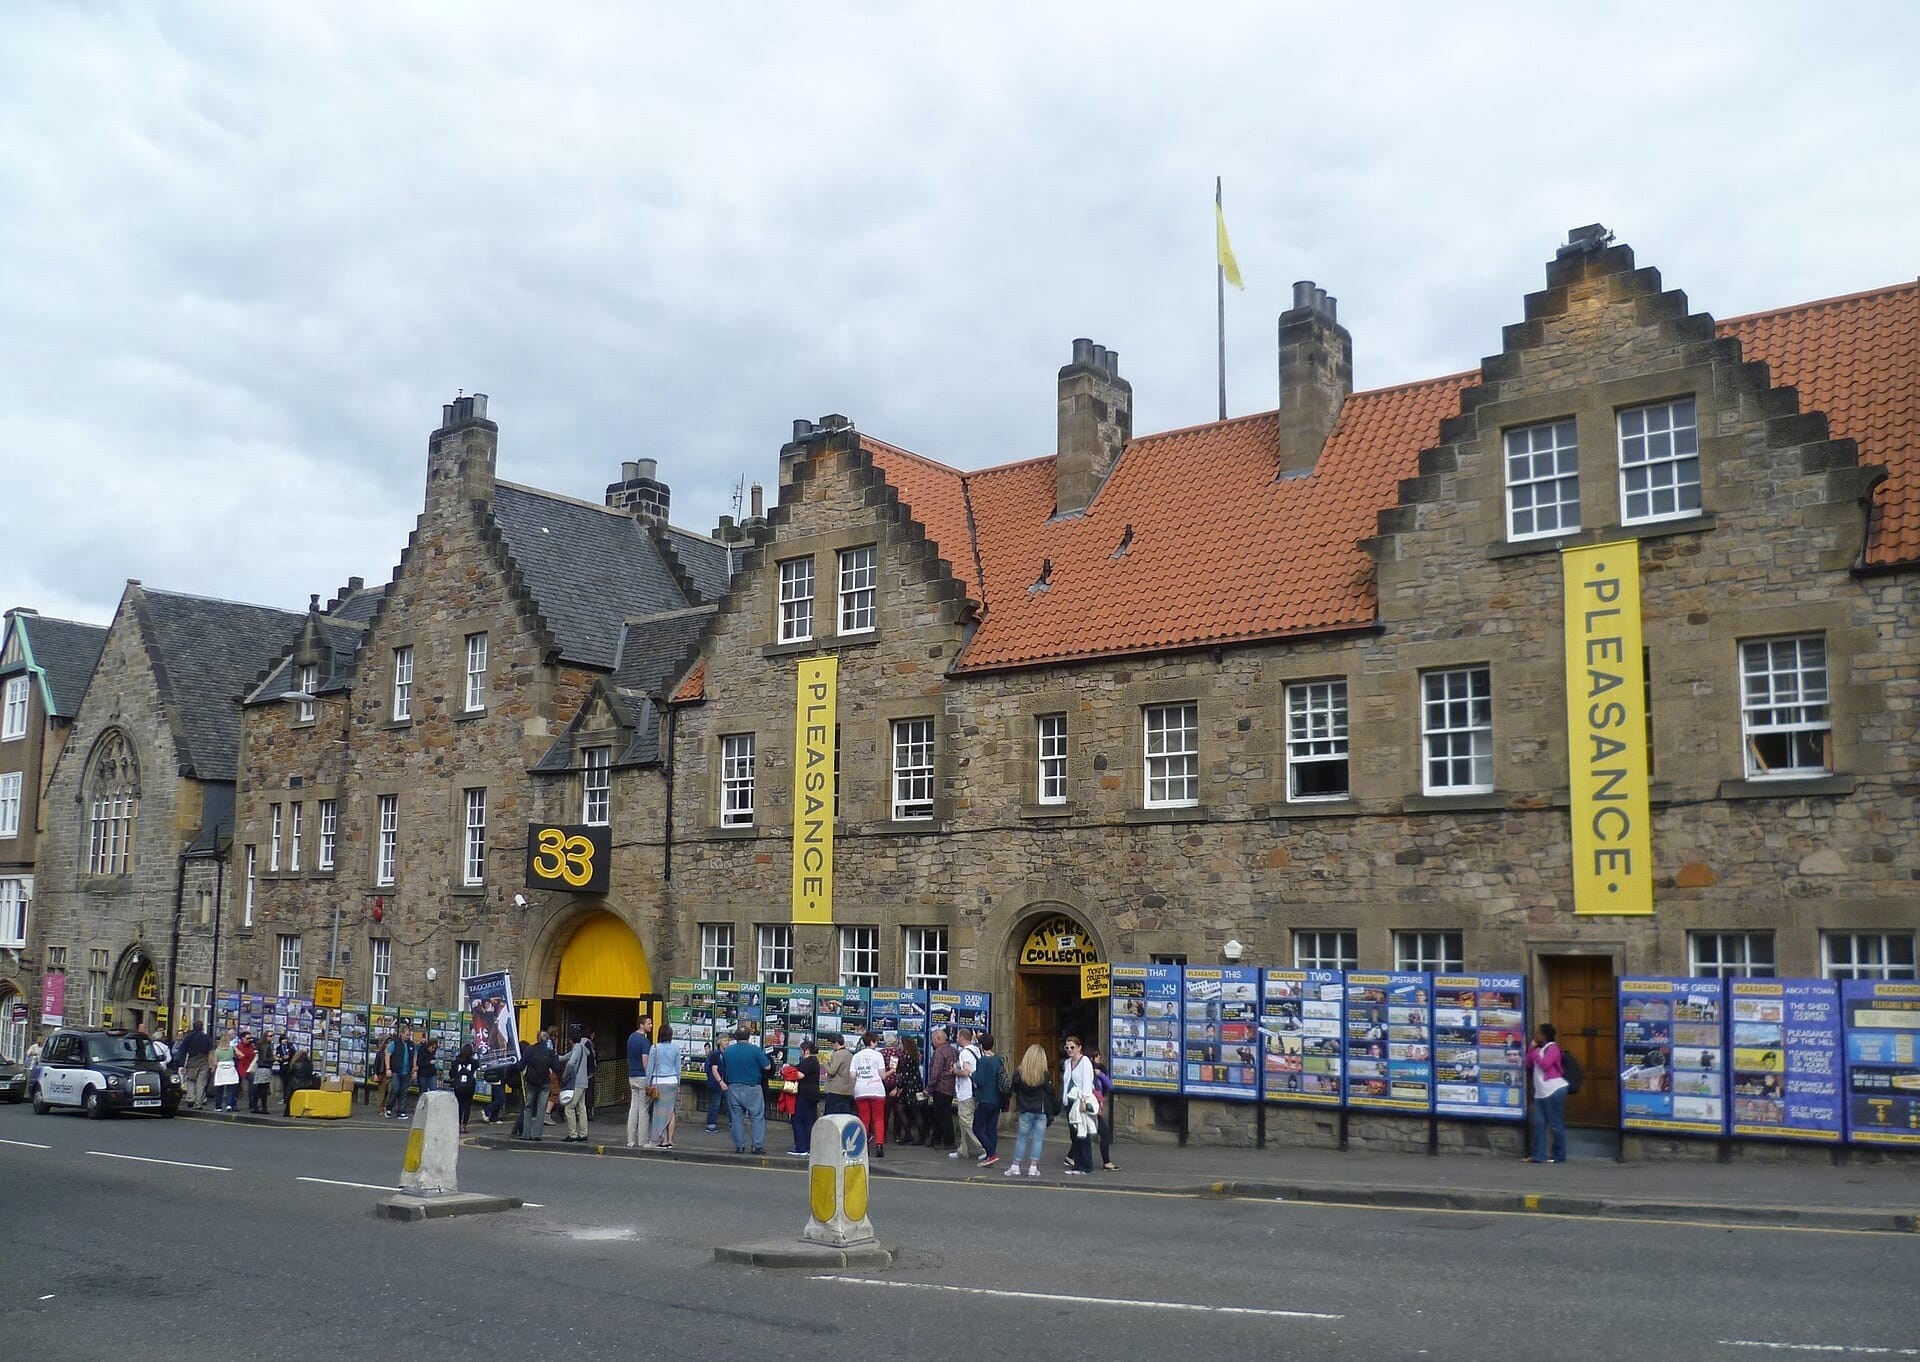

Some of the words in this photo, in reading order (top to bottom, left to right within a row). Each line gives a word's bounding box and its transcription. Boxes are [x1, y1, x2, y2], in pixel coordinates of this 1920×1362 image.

[1583, 578, 1632, 876] PLEASANCE
[803, 683, 827, 897] PLEASANCE
[534, 829, 595, 887] 33
[1149, 969, 1168, 977] THAT
[1224, 970, 1242, 978] THIS
[1310, 972, 1332, 982] TWO
[1387, 975, 1423, 984] UPSTAIRS
[1480, 979, 1491, 987] 10
[1492, 979, 1521, 988] DOME
[740, 983, 760, 991] GRAND
[1673, 983, 1689, 991] THE
[1691, 984, 1720, 992] GREEN
[1813, 987, 1835, 995] TOWN
[1790, 1002, 1805, 1010] THE
[1807, 1003, 1830, 1011] SHED
[1788, 1029, 1834, 1038] PLEASANCE
